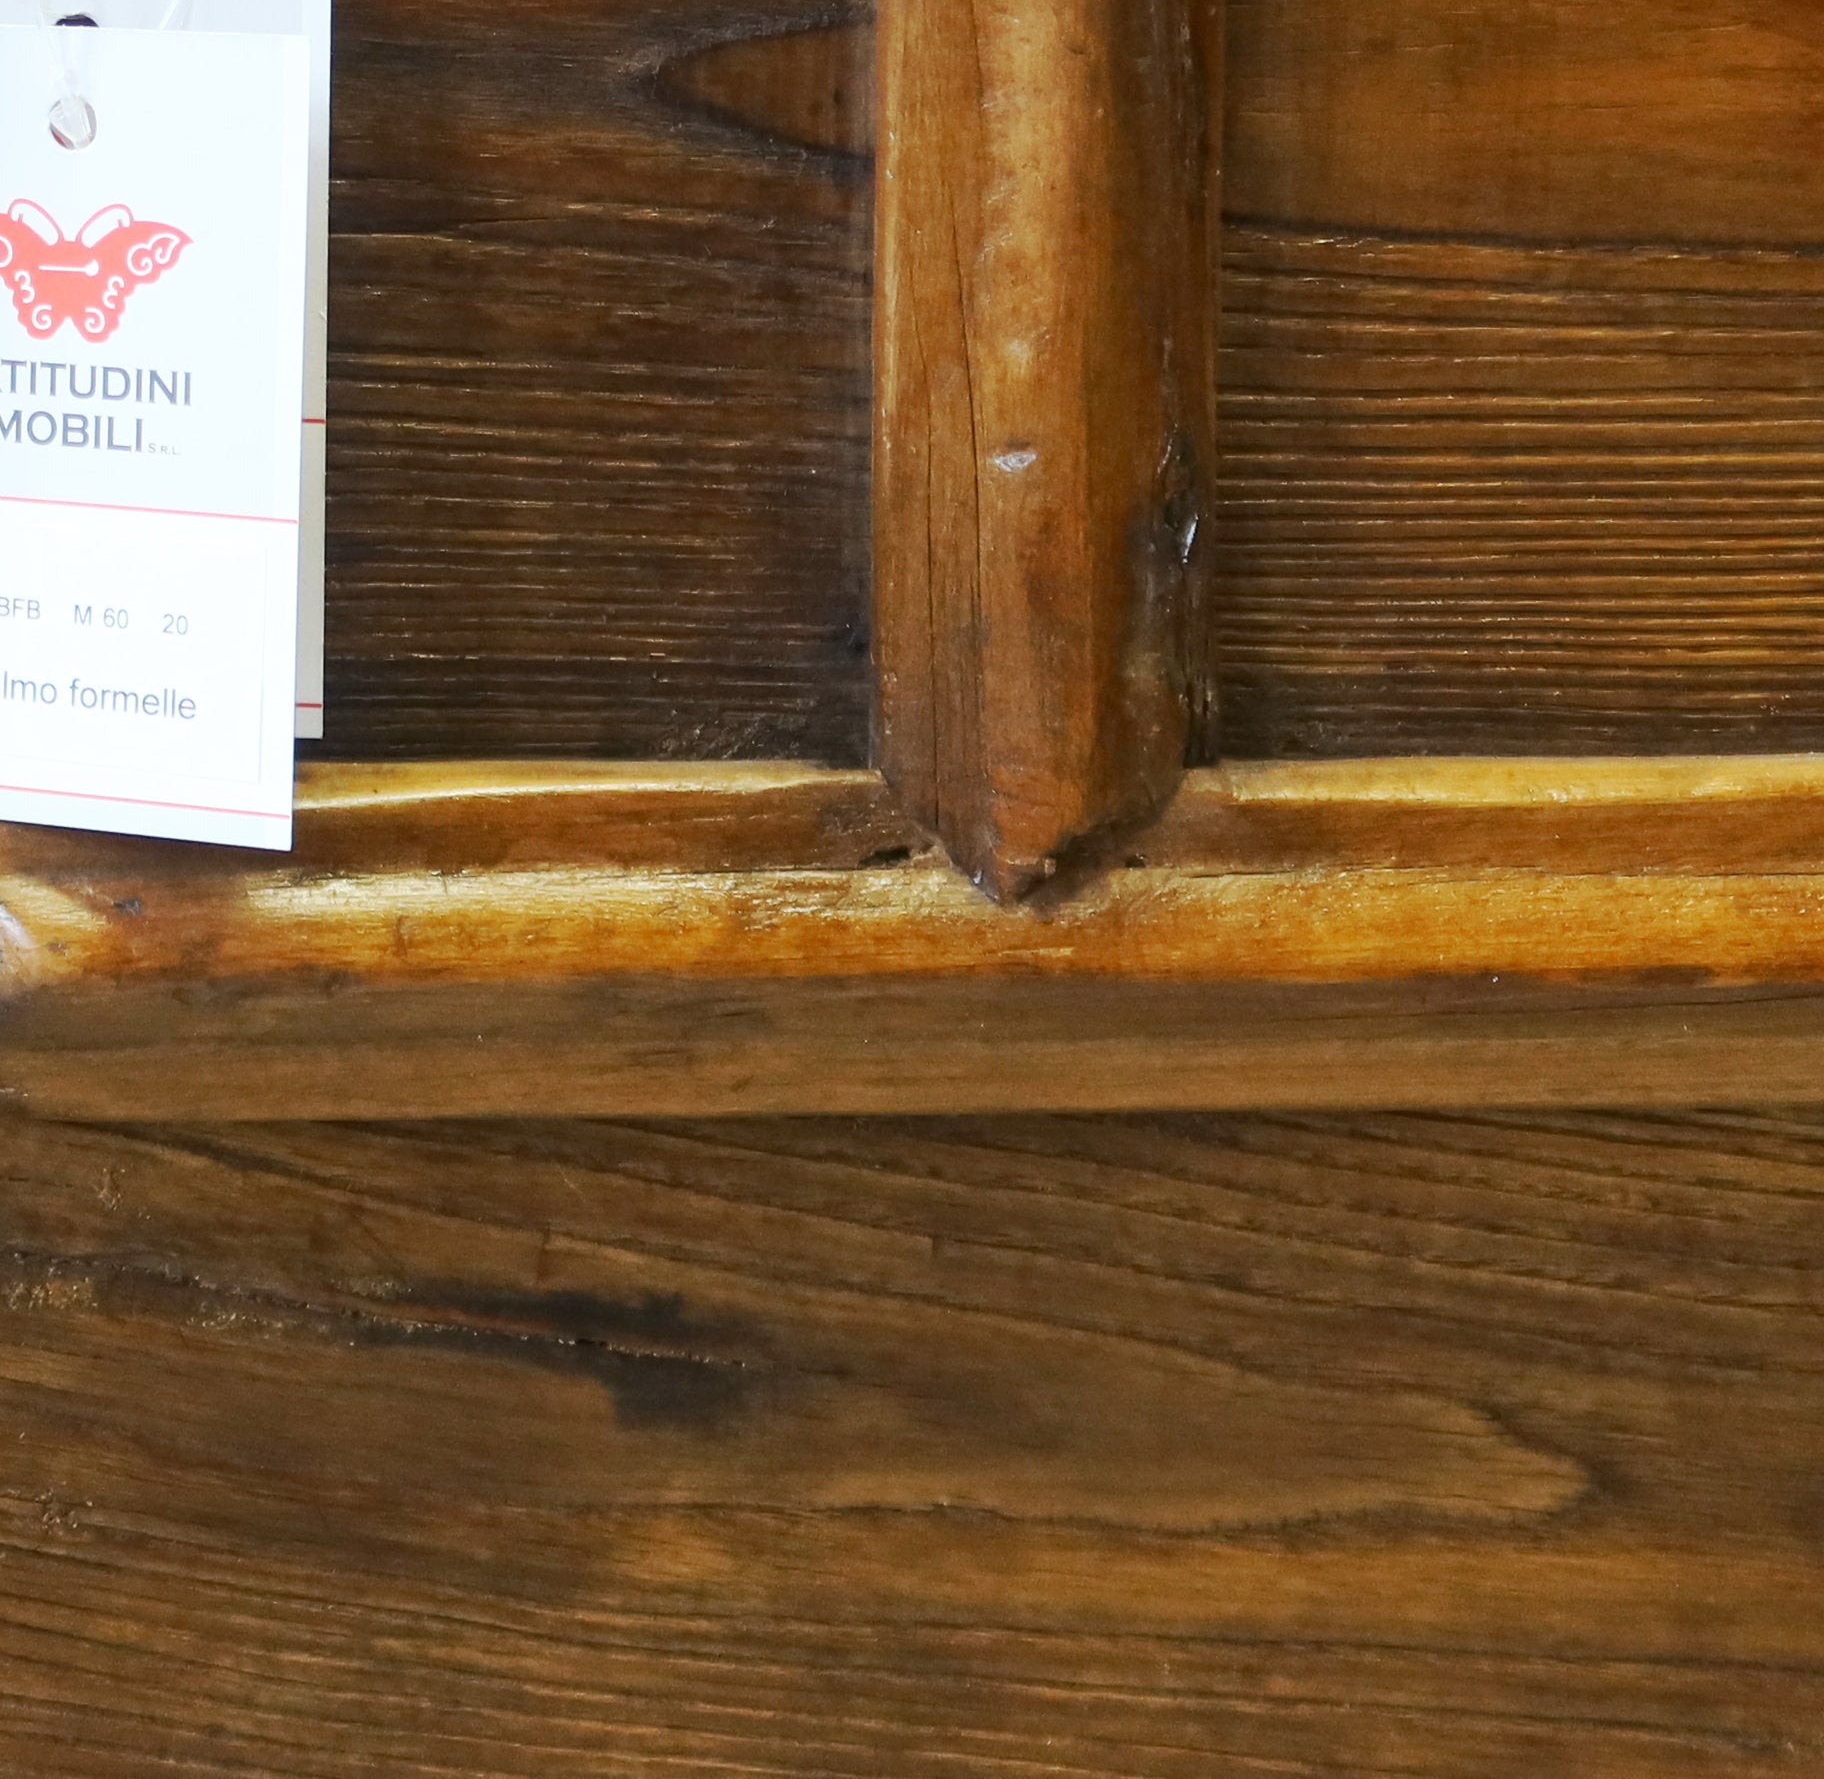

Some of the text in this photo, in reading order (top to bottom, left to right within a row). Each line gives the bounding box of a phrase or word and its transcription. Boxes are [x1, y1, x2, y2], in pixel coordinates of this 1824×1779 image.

[74, 604, 93, 625] M
[103, 607, 129, 630] 60
[162, 613, 189, 636] 20
[69, 677, 197, 720] formelle
